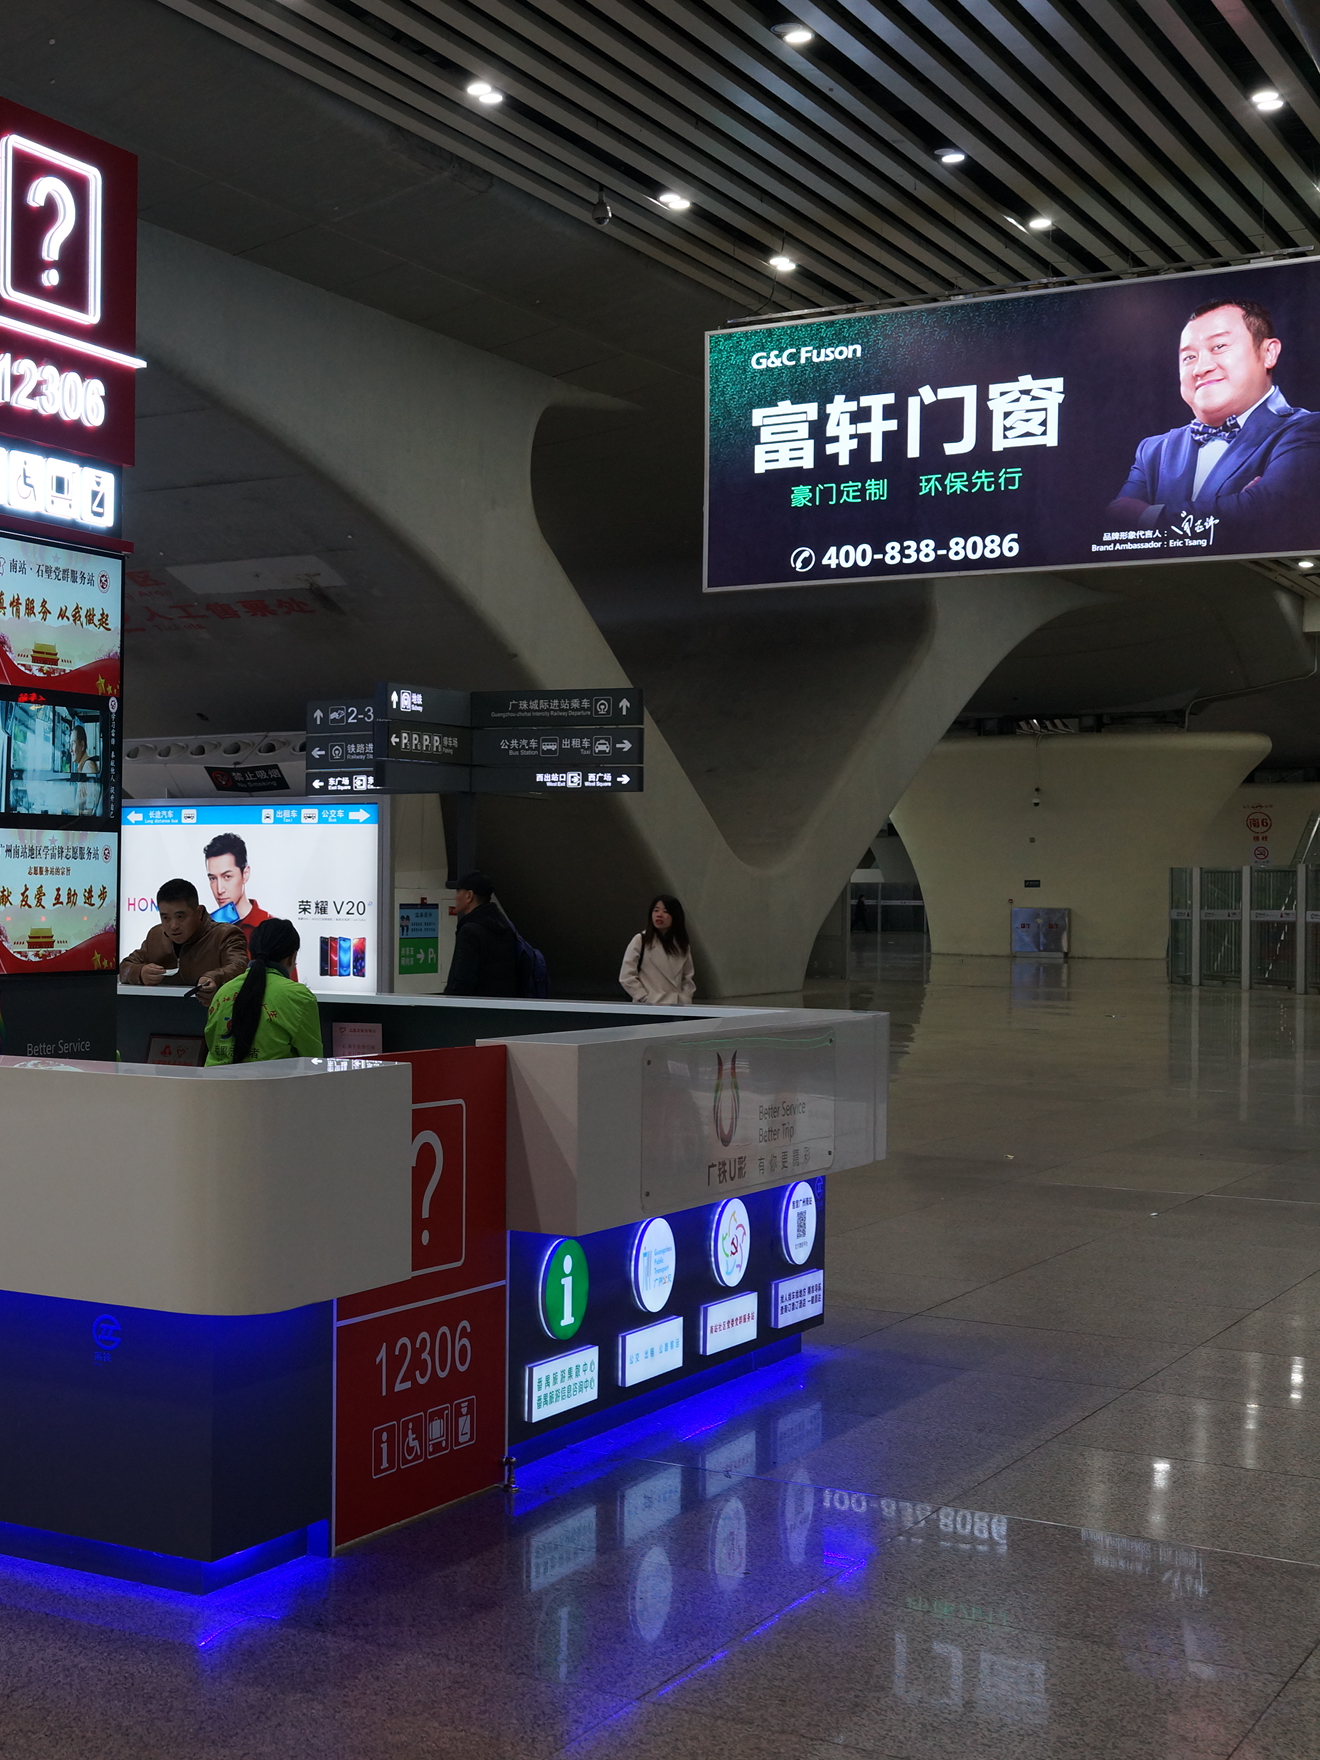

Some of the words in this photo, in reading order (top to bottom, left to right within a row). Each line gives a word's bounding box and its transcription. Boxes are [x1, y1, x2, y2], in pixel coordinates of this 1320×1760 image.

[751, 348, 796, 369] G&C
[800, 342, 862, 363] Fuson
[752, 374, 1065, 474] 富轩门窗
[790, 478, 888, 508] 豪门定制
[919, 467, 1023, 498] 环保先行
[822, 534, 1019, 569] 400-838-8086
[1092, 543, 1114, 552] Brand
[1169, 538, 1183, 547] Eric
[1184, 538, 1207, 547] Tsang
[57, 602, 112, 632] 从我做起
[509, 699, 591, 710] 广珠城际进站乘车
[348, 706, 374, 722] 2-3
[500, 739, 538, 749] 公共汽车
[562, 738, 591, 749] 出租车
[231, 769, 281, 781] 禁止吸烟
[247, 780, 277, 789] Smoking
[321, 809, 345, 818] 公交车
[19, 884, 46, 909] 友爱
[52, 886, 78, 908] 互助
[83, 885, 108, 909] 进步
[298, 900, 328, 915] 荣耀
[333, 900, 366, 915] V20
[26, 1042, 53, 1057] Better
[57, 1039, 91, 1054] Service
[759, 1105, 780, 1120] Better
[759, 1128, 780, 1143] Better
[375, 1320, 472, 1397] 12306
